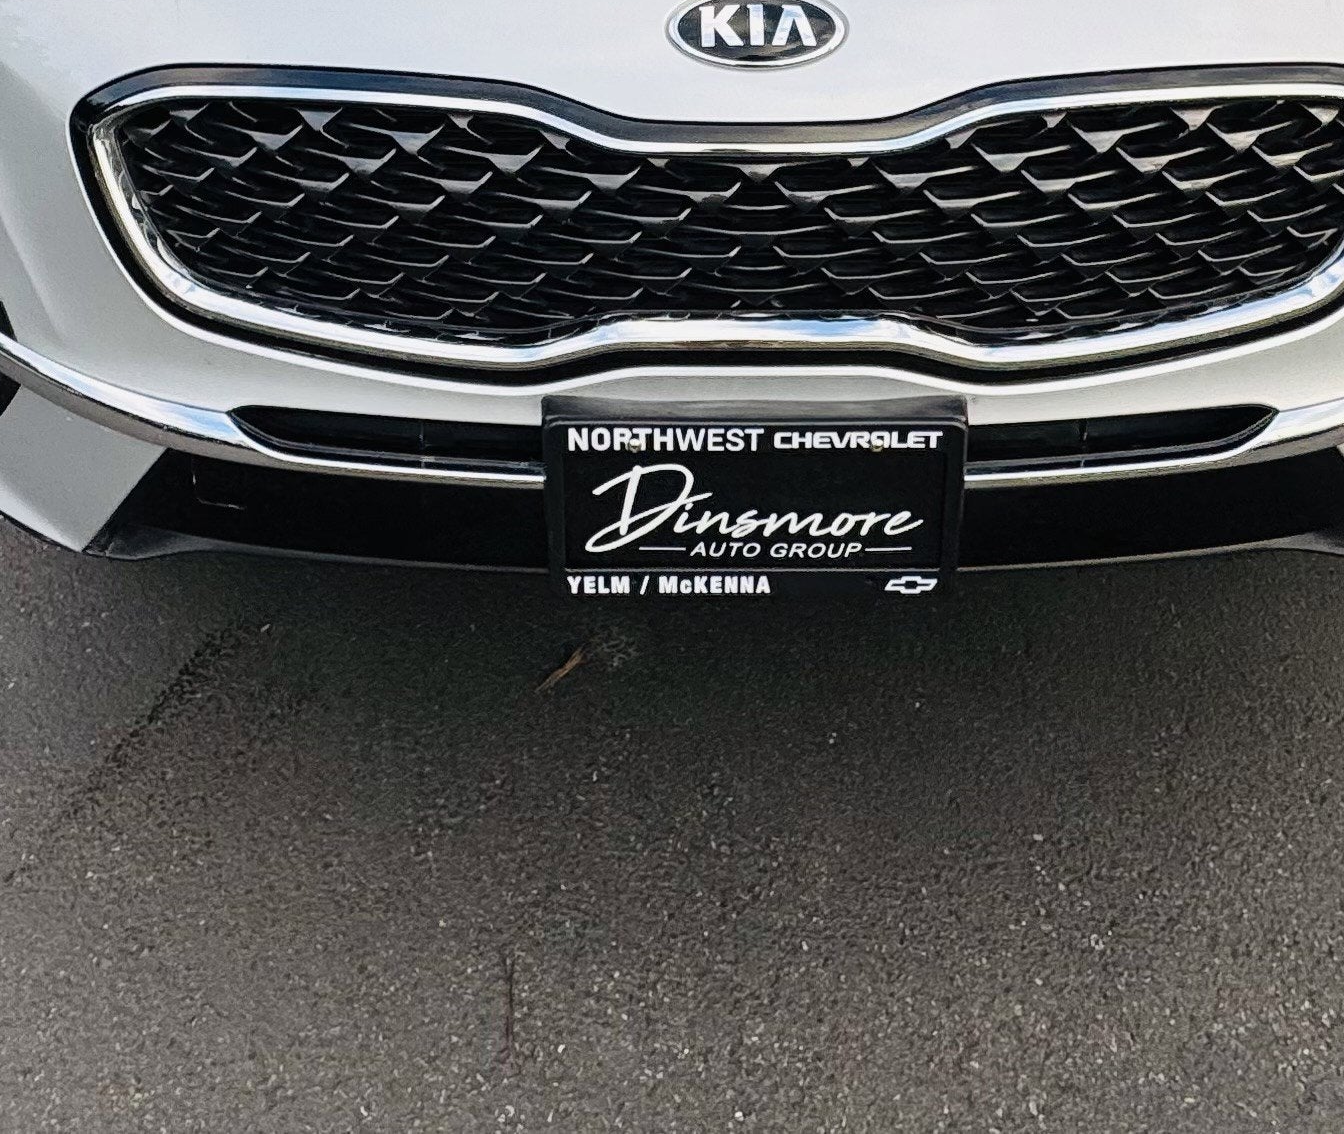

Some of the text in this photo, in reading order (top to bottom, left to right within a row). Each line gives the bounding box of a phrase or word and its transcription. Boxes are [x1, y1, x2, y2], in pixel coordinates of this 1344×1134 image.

[698, 3, 818, 47] KIA
[567, 427, 944, 452] NORTHWEST CHEVROLET
[584, 463, 924, 554] Dinsmore
[689, 542, 863, 559] AUTO GROUP
[566, 575, 631, 595] YELM
[658, 575, 771, 595] McKENNA
